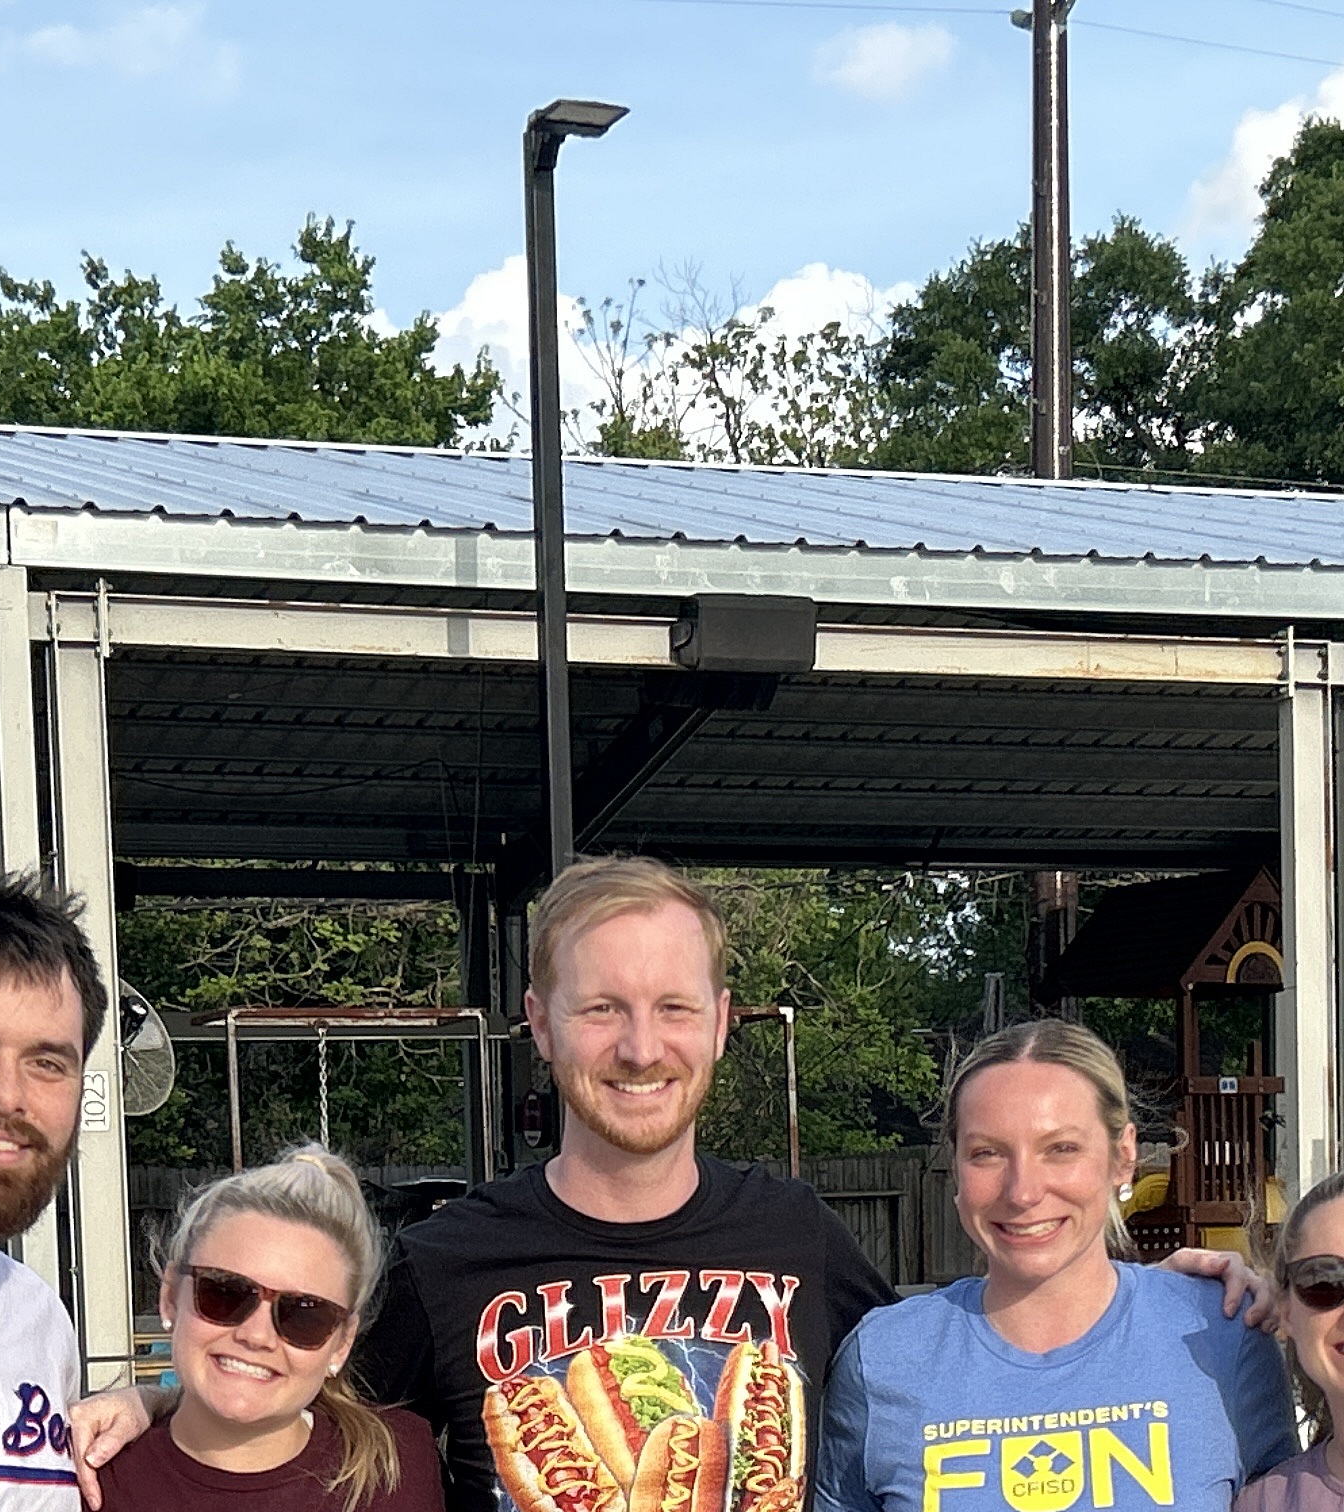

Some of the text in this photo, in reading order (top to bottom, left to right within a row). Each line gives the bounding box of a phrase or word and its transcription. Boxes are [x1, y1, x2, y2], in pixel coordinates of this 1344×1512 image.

[84, 1074, 105, 1127] 1023
[476, 1268, 801, 1385] GLIZZY
[923, 1400, 1170, 1441] SUPERINTENDENT'S
[1012, 1478, 1076, 1498] CFISD
